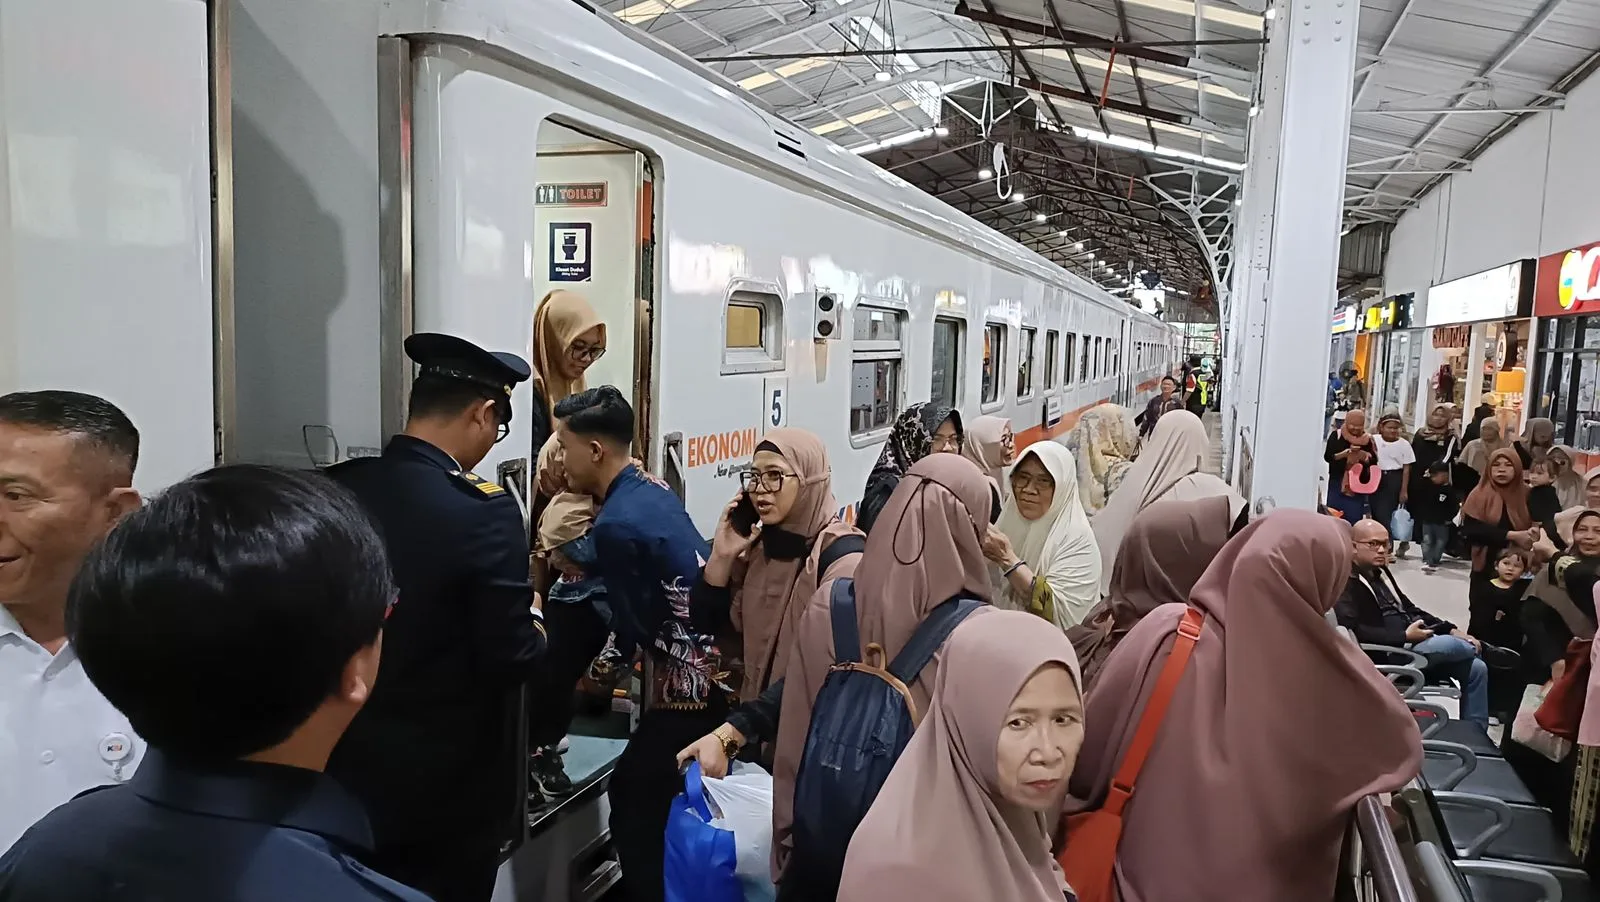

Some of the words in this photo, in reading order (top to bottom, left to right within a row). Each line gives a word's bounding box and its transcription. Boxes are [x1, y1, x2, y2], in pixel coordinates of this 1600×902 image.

[560, 189, 602, 199] TOILET
[771, 390, 781, 427] 5
[687, 427, 757, 468] EKONOMI
